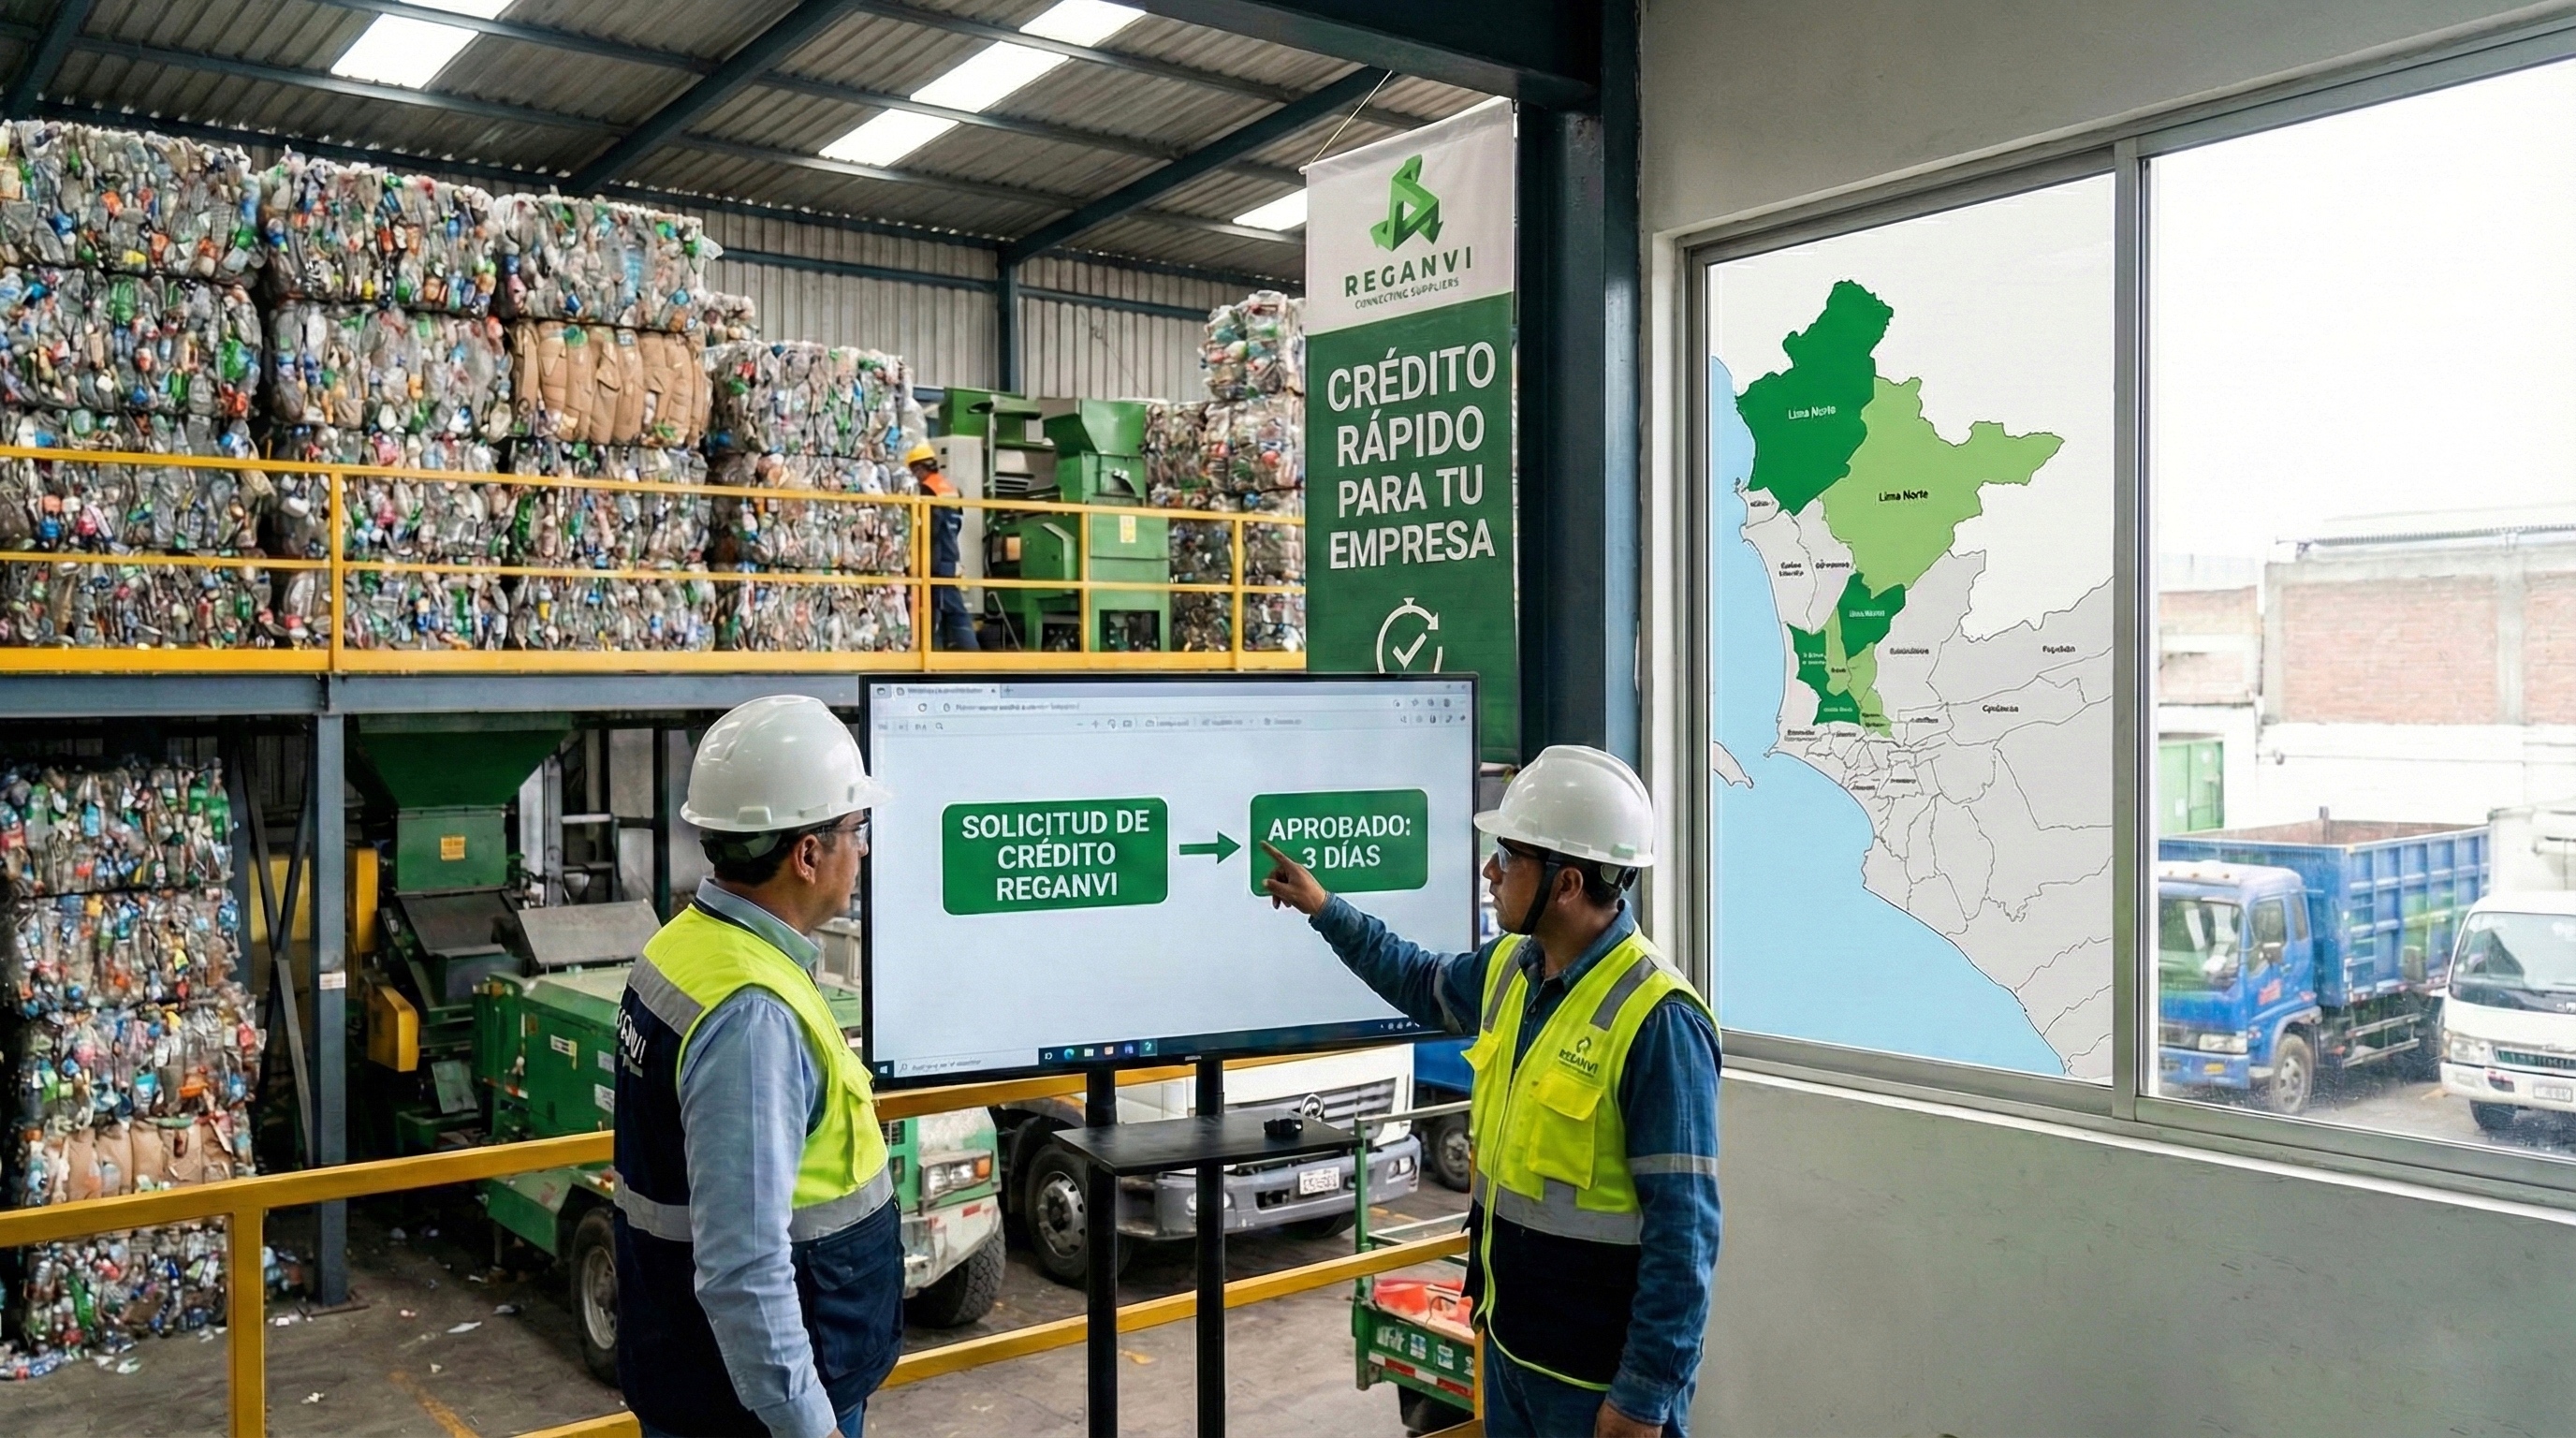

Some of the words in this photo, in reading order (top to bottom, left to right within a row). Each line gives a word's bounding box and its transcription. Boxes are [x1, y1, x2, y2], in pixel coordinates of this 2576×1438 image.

[1344, 246, 1471, 298] REGANVI
[1327, 342, 1497, 412] CRÉDITO
[1338, 404, 1486, 467] RÁPIDO
[1339, 472, 1428, 519] PARA
[1435, 463, 1484, 507] TU
[1329, 518, 1496, 569] EMPRESA
[961, 811, 1108, 840] SOLICITUD
[1116, 809, 1150, 833] DE
[1267, 814, 1411, 842] APROBADO:
[998, 837, 1117, 870] CRÉDITO
[1302, 846, 1317, 870] 3
[1325, 840, 1381, 869] DÍAS
[996, 872, 1118, 902] REGANVI
